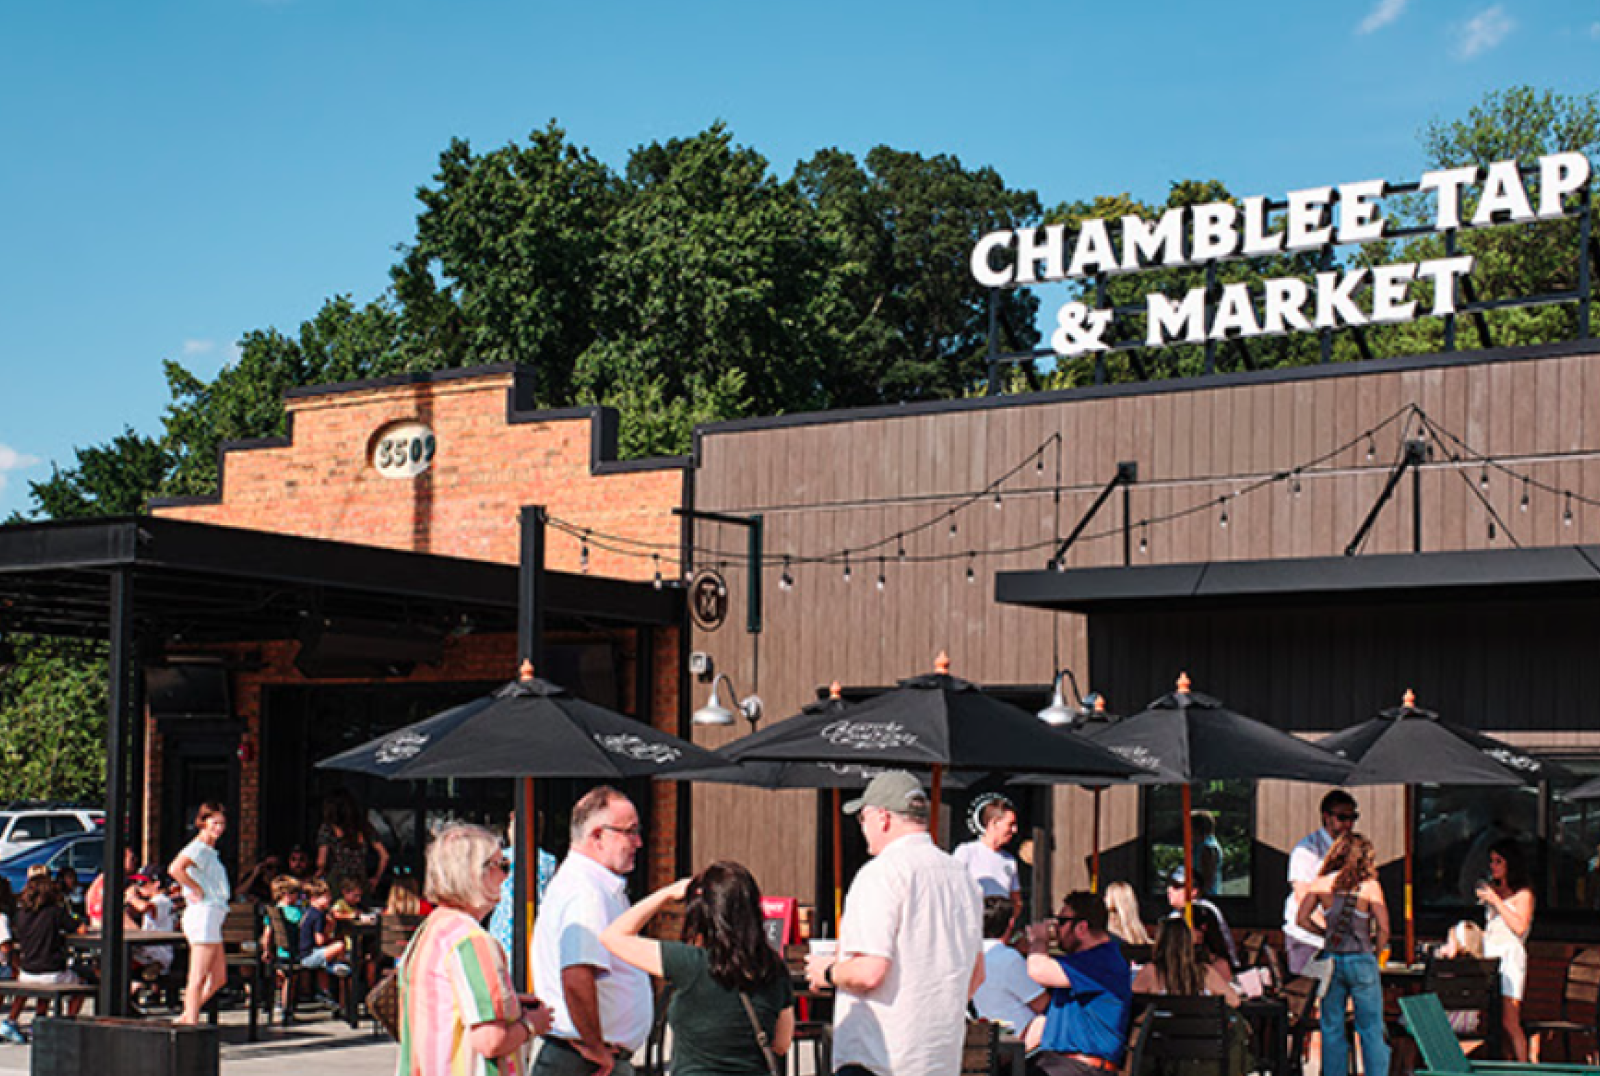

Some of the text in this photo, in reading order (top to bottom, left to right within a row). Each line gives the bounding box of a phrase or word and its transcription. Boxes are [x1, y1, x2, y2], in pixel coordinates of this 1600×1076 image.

[970, 151, 1592, 288] CHAMBLEE TAP
[1051, 255, 1475, 357] & MARKET
